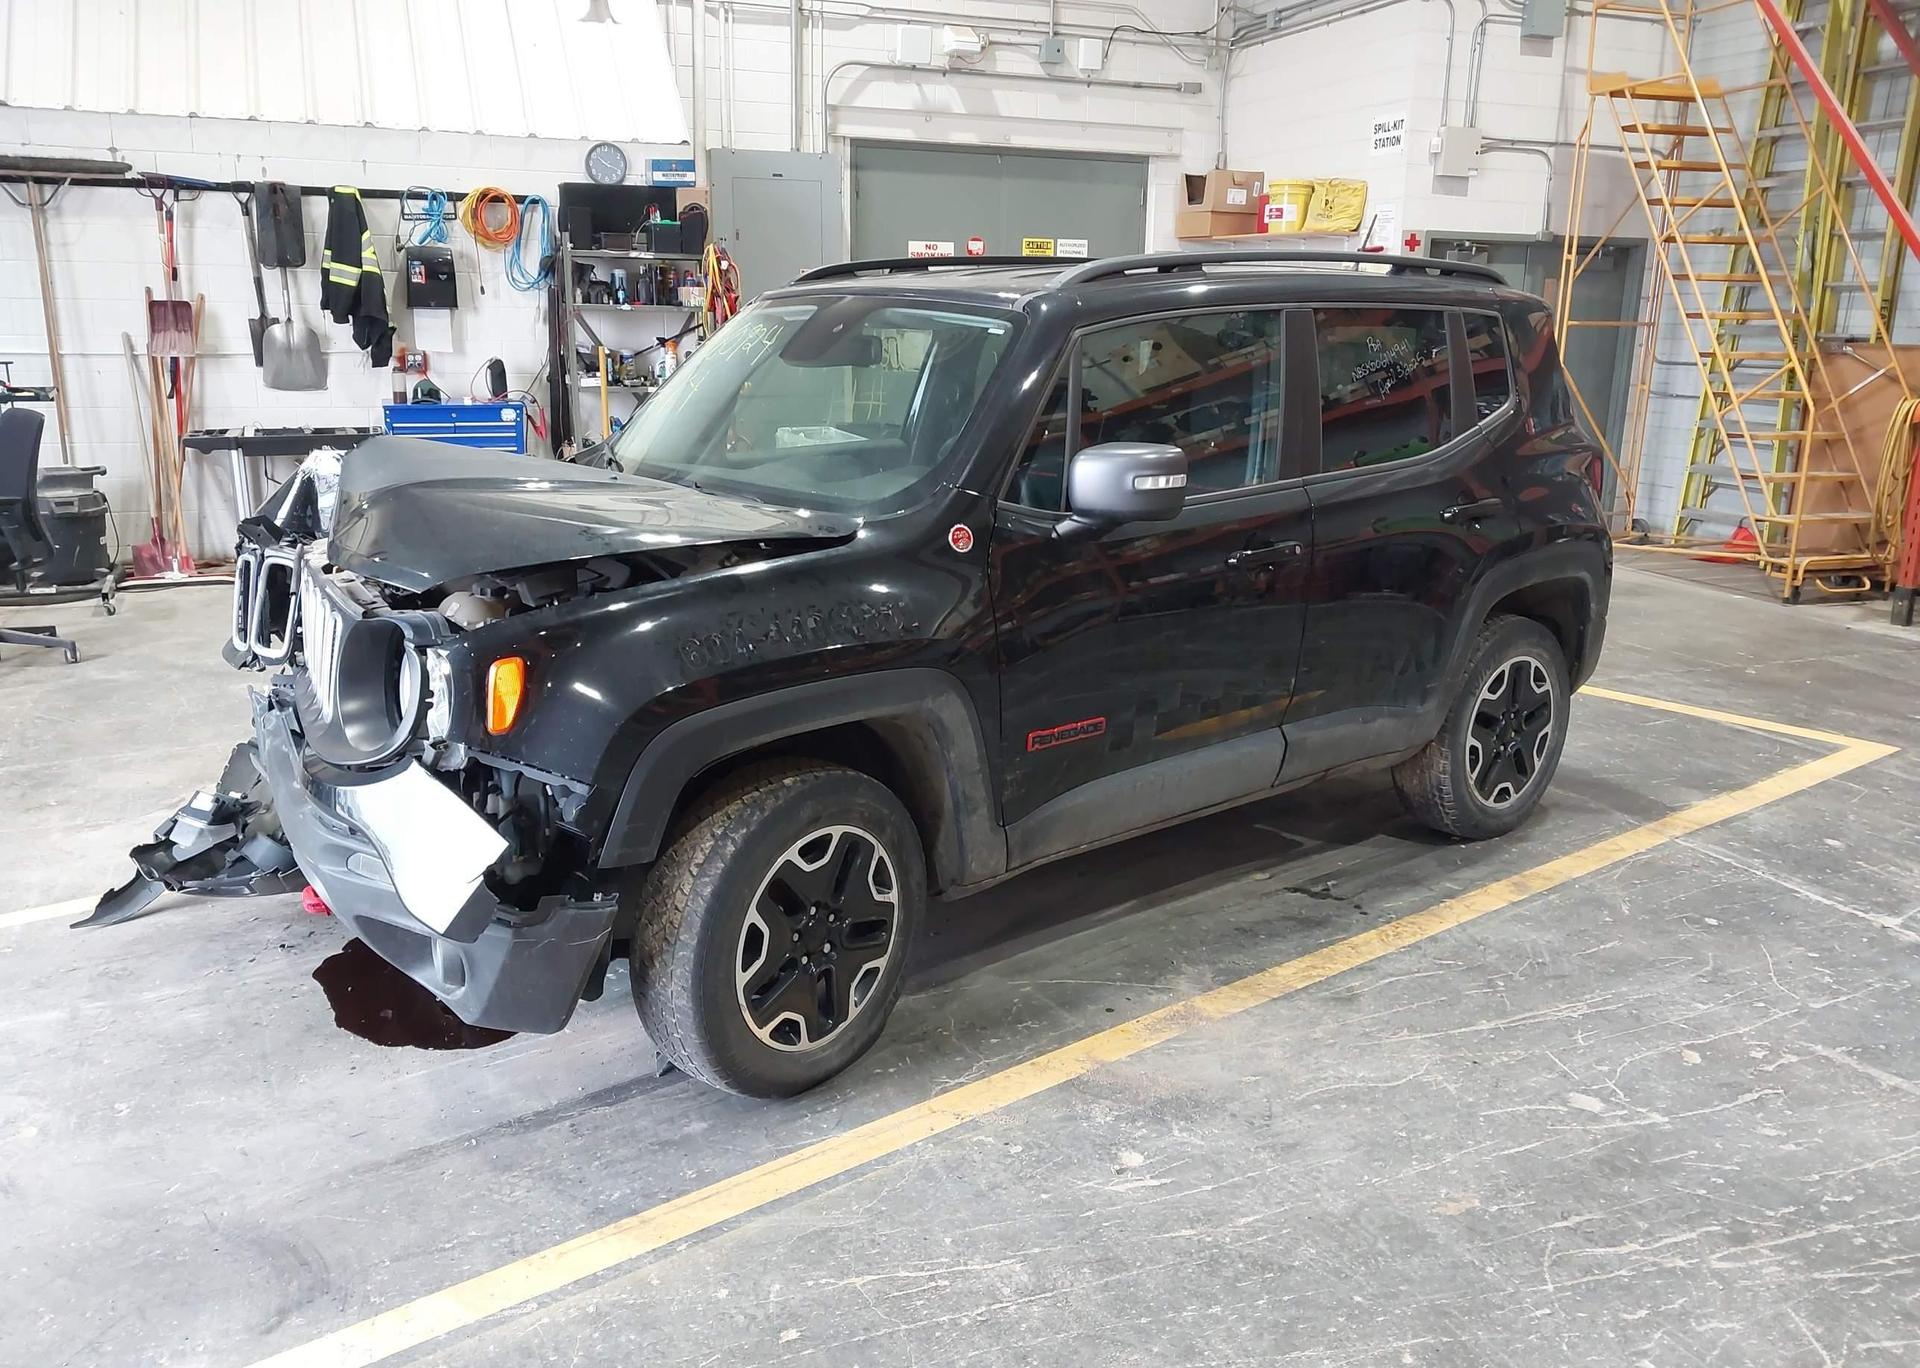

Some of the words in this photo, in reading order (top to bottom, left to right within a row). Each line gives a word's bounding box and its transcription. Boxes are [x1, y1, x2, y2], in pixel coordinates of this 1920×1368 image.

[1374, 119, 1404, 135] SPILL-KIT
[1374, 135, 1401, 149] STATION
[1029, 718, 1105, 751] RENEGADE
